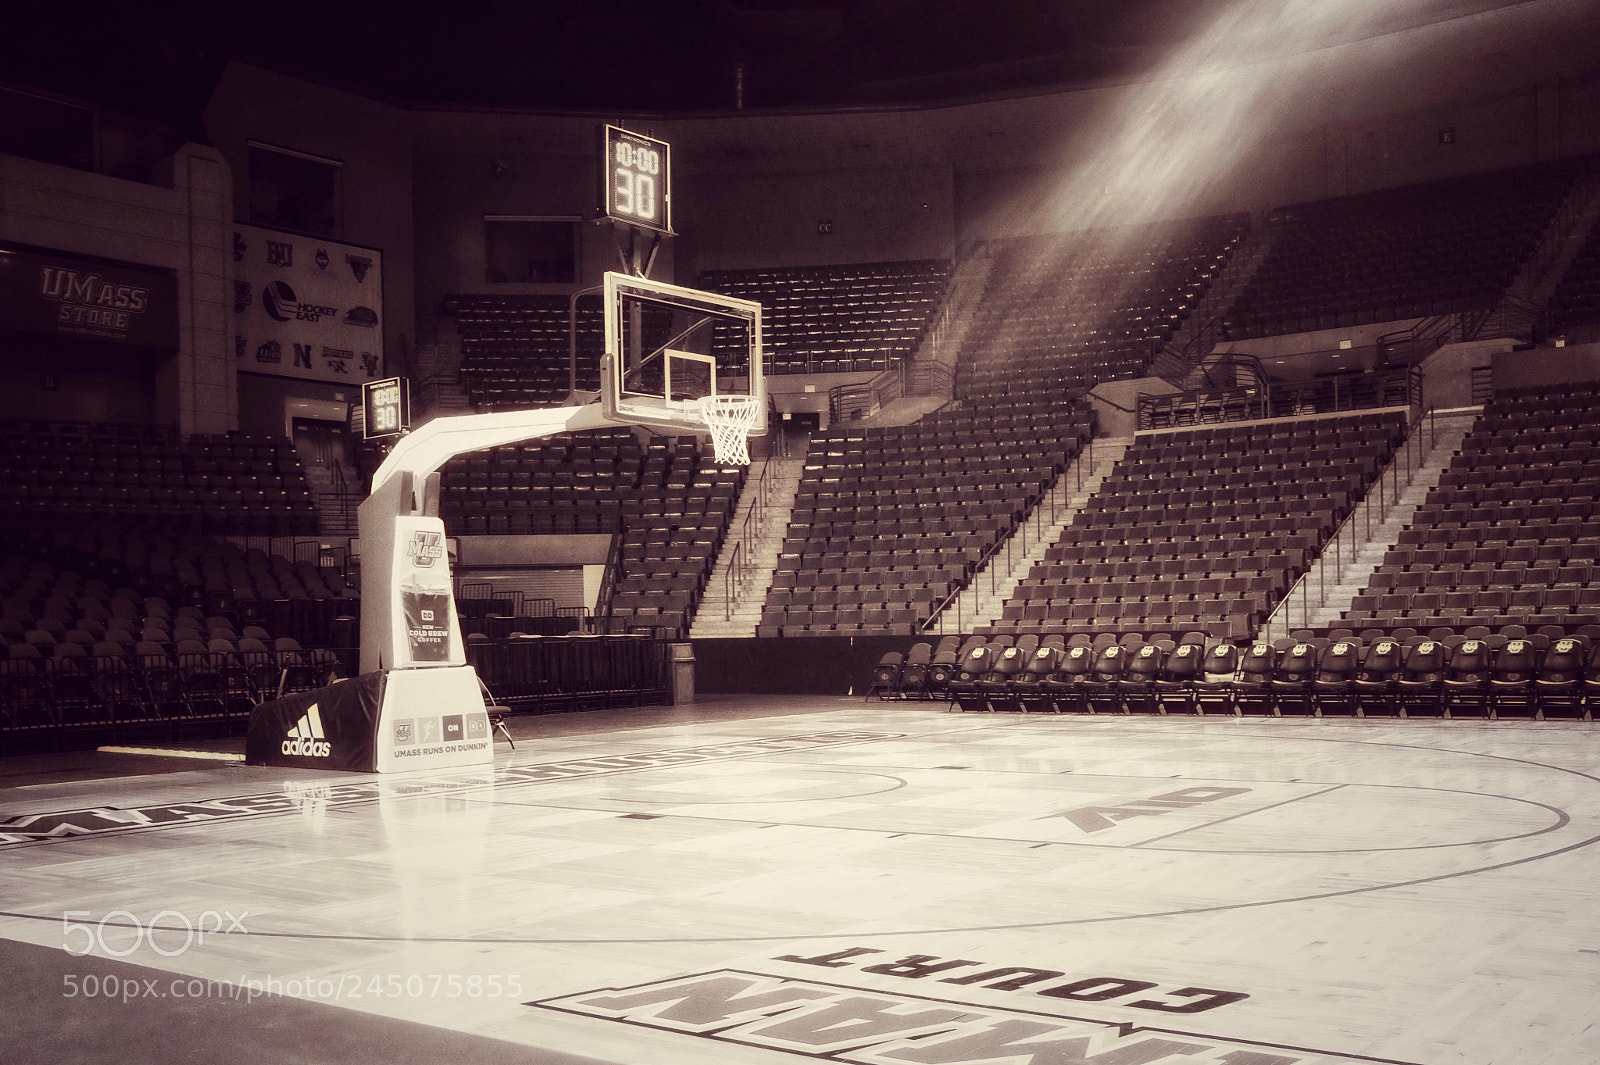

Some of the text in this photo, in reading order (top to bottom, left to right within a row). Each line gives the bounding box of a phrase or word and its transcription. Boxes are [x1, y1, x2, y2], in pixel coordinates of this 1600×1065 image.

[615, 142, 660, 175] 10:00
[615, 167, 655, 219] 30
[266, 240, 293, 268] BU
[59, 304, 129, 330] STORE
[295, 311, 321, 323] EAST
[297, 303, 338, 317] HOCKEY
[293, 342, 313, 370] N
[376, 406, 397, 430] 30
[409, 630, 428, 638] COLD
[447, 724, 459, 732] ON
[468, 719, 486, 732] DD
[281, 736, 331, 757] adidas
[394, 748, 421, 758] UMASS
[423, 746, 444, 756] RUNS
[445, 745, 457, 753] ON
[770, 947, 1250, 1014] COURT
